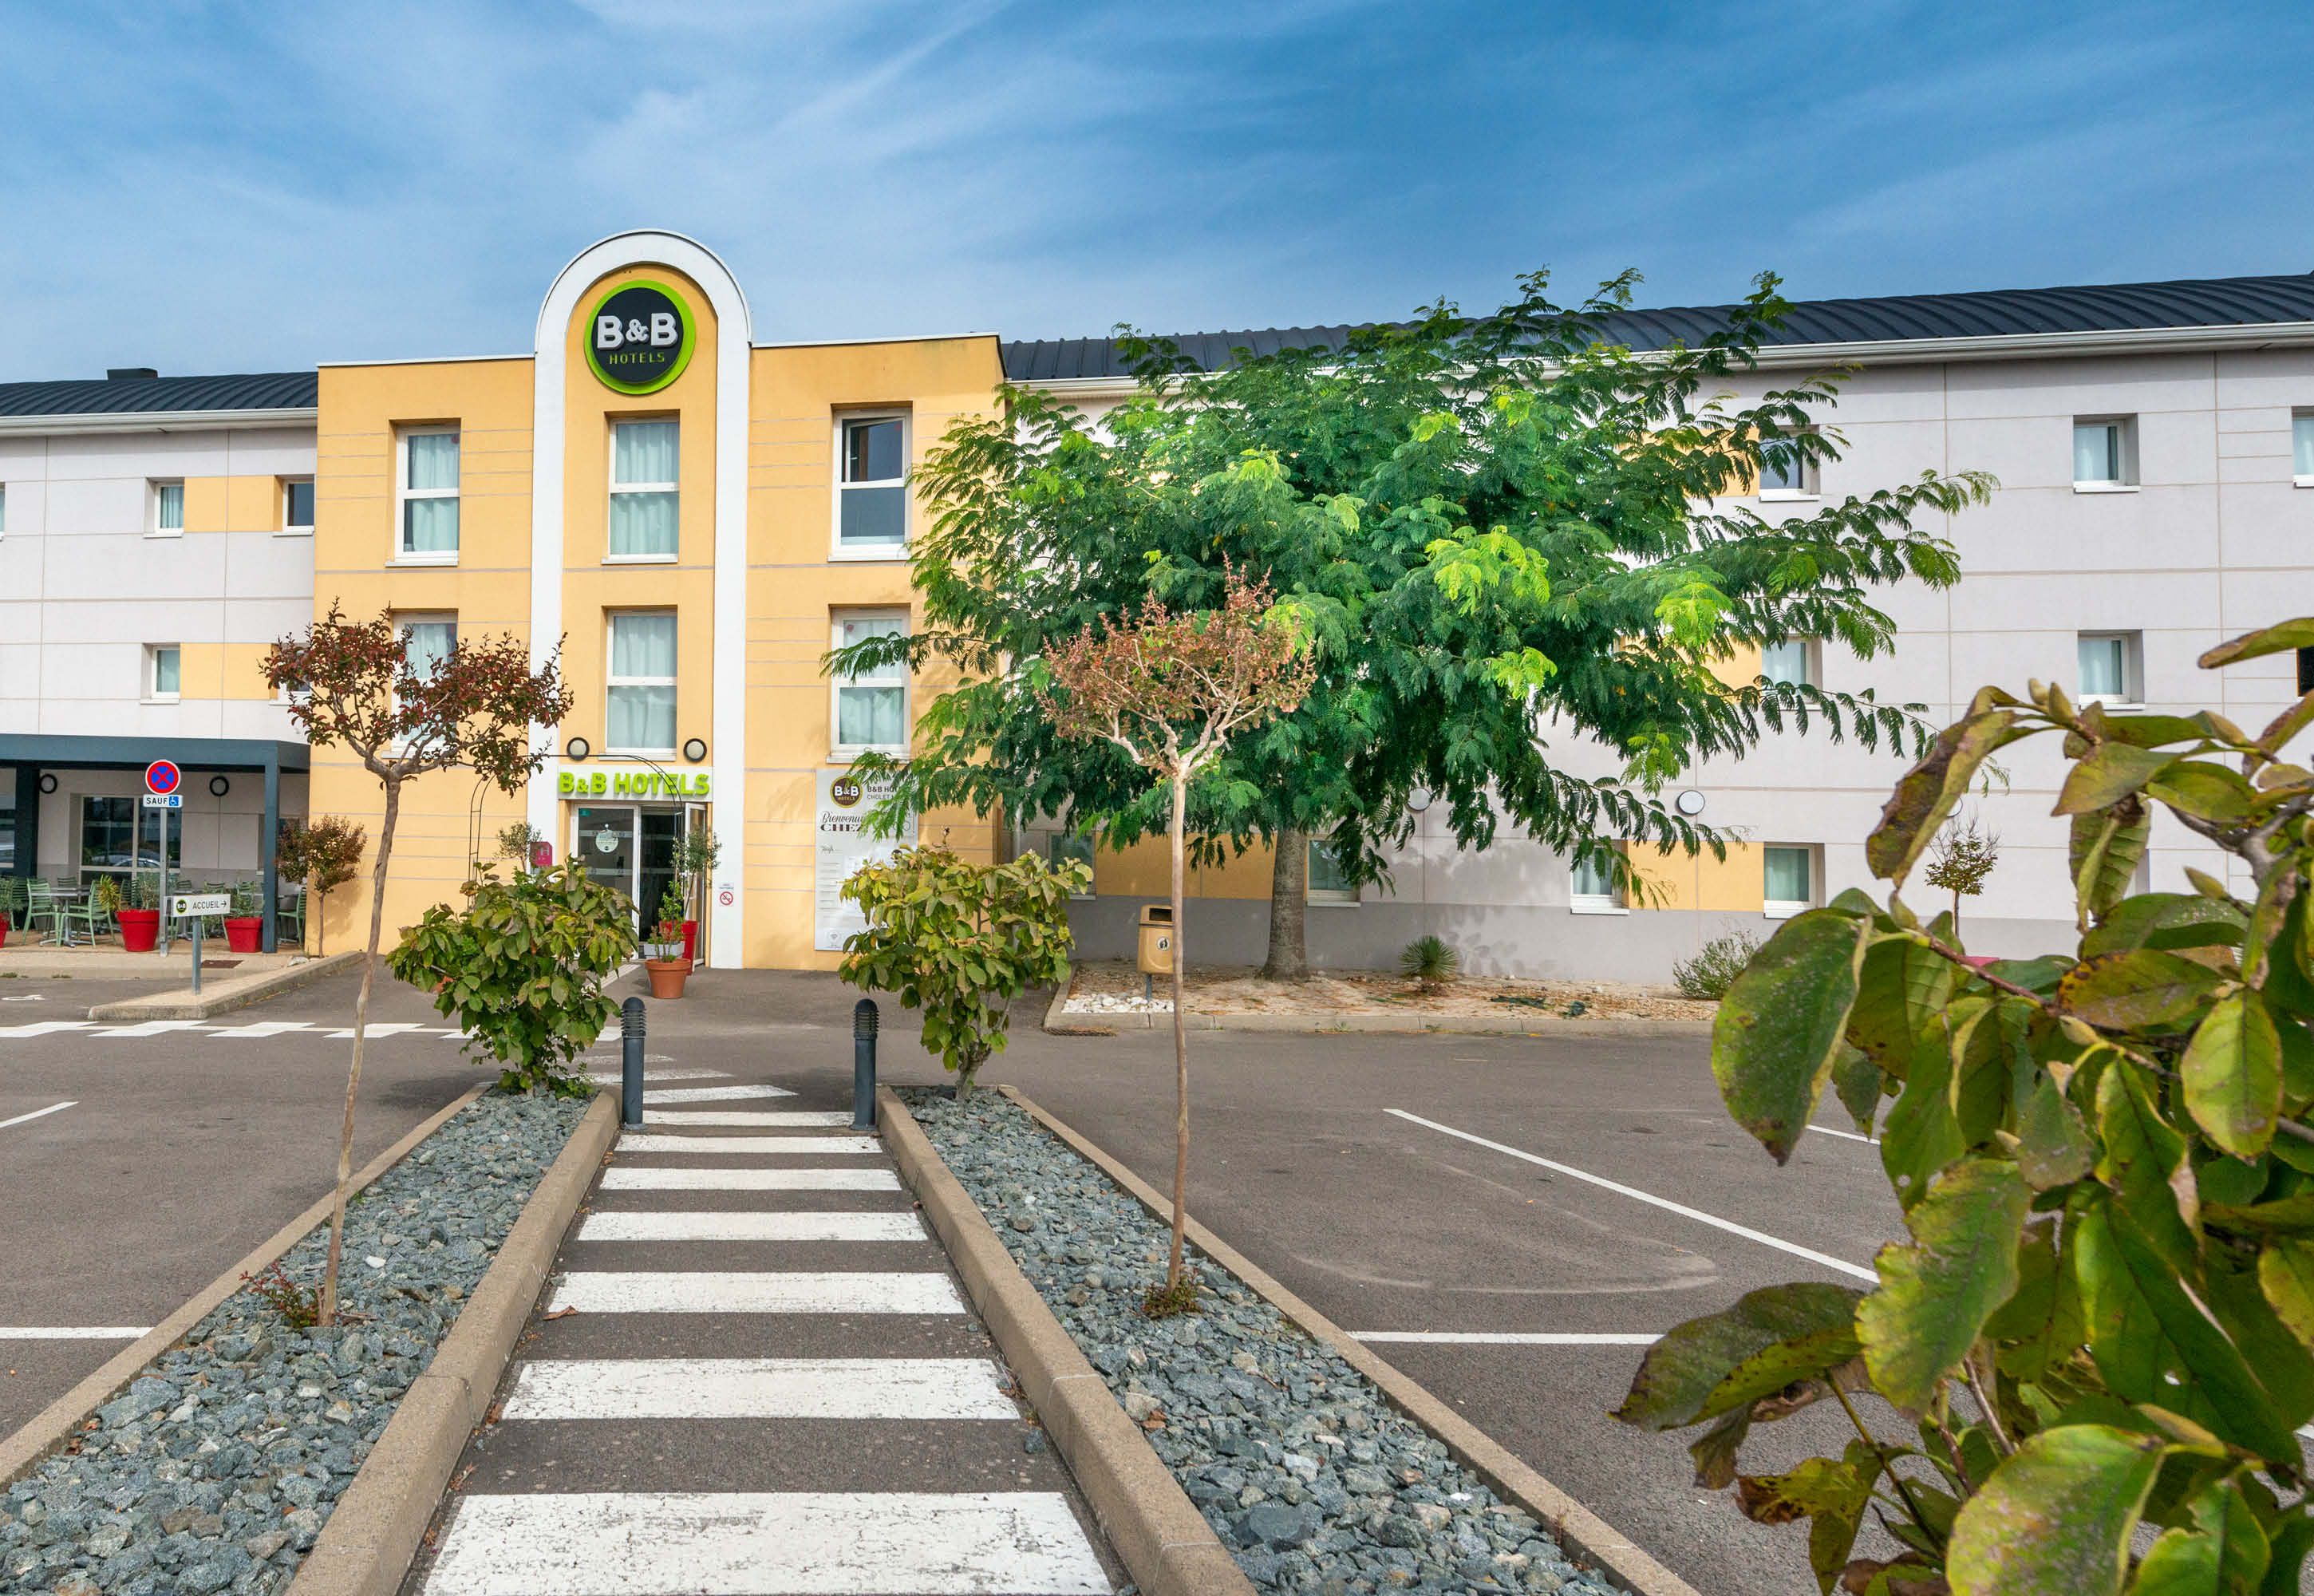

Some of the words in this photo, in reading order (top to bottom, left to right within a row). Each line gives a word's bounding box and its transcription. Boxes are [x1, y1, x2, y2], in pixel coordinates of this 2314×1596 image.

[597, 312, 678, 350] B&B
[609, 351, 665, 365] HOTELS
[559, 772, 607, 793] B&B
[614, 772, 710, 796] HOTELS
[834, 785, 859, 796] B&B
[822, 810, 863, 824] Bienvenu
[192, 900, 220, 910] ACCUEIL
